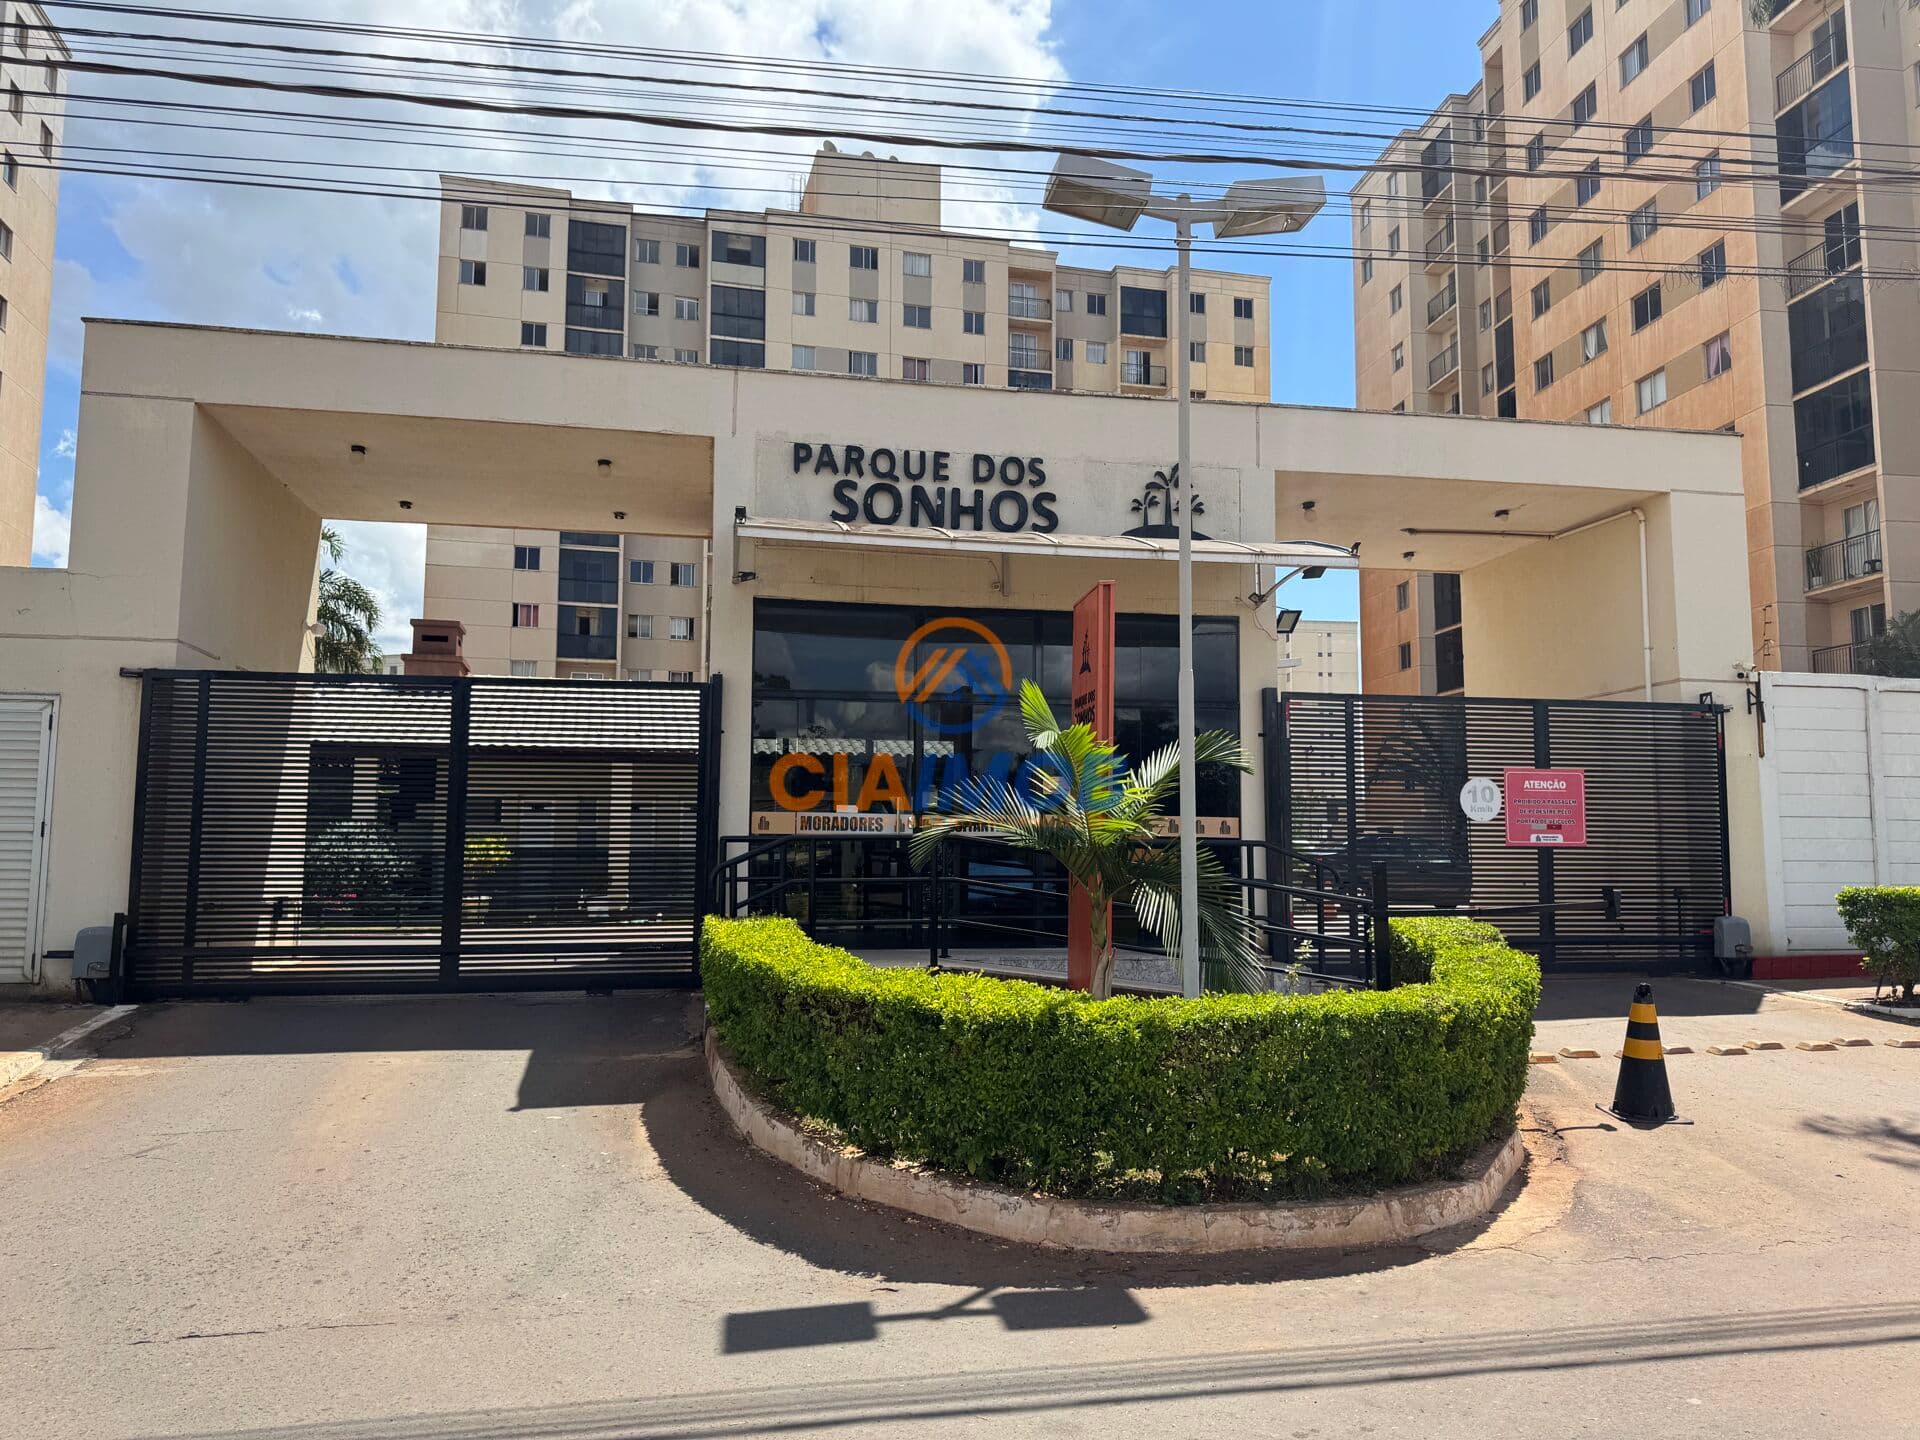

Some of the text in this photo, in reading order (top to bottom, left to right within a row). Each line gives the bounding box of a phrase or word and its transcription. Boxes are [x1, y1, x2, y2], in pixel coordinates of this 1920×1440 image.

[793, 442, 1047, 487] PARQUE DOS
[830, 479, 1059, 534] SONHOS
[1523, 779, 1566, 791] ATENÇÃO
[1467, 785, 1495, 803] 10
[1470, 805, 1493, 813] Km/h
[800, 815, 884, 832] MORADORES
